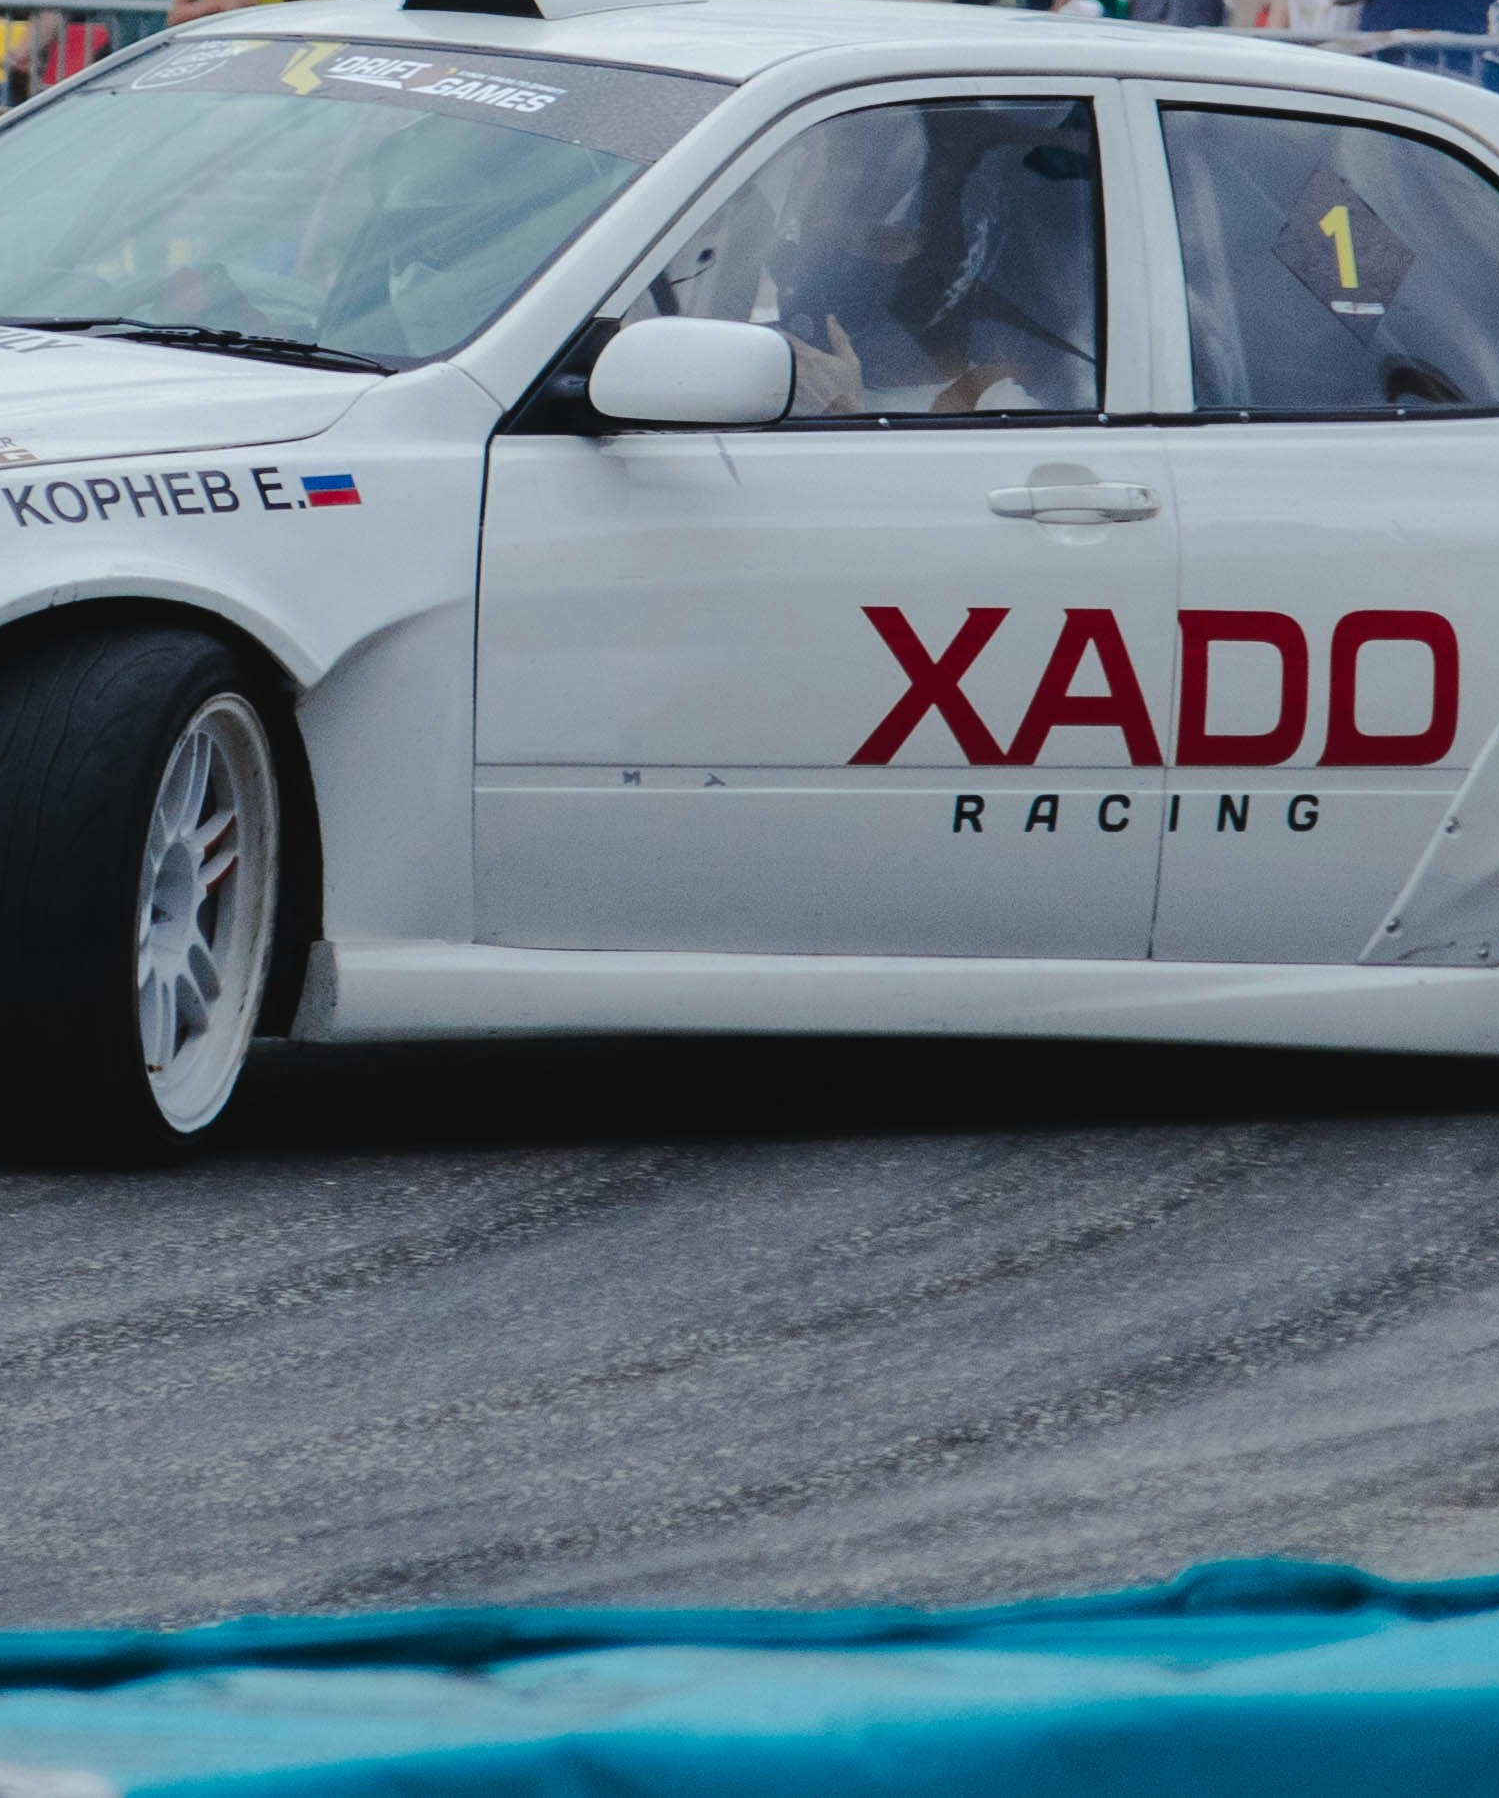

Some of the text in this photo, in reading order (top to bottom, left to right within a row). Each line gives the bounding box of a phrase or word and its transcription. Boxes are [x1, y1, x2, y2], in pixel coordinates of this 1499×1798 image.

[328, 55, 433, 80] DRIFT
[417, 77, 557, 113] GAMES
[1318, 205, 1359, 289] 1
[1, 468, 239, 528] КОРНЕВ
[846, 605, 1460, 767] XADO
[952, 794, 1321, 833] RACING
